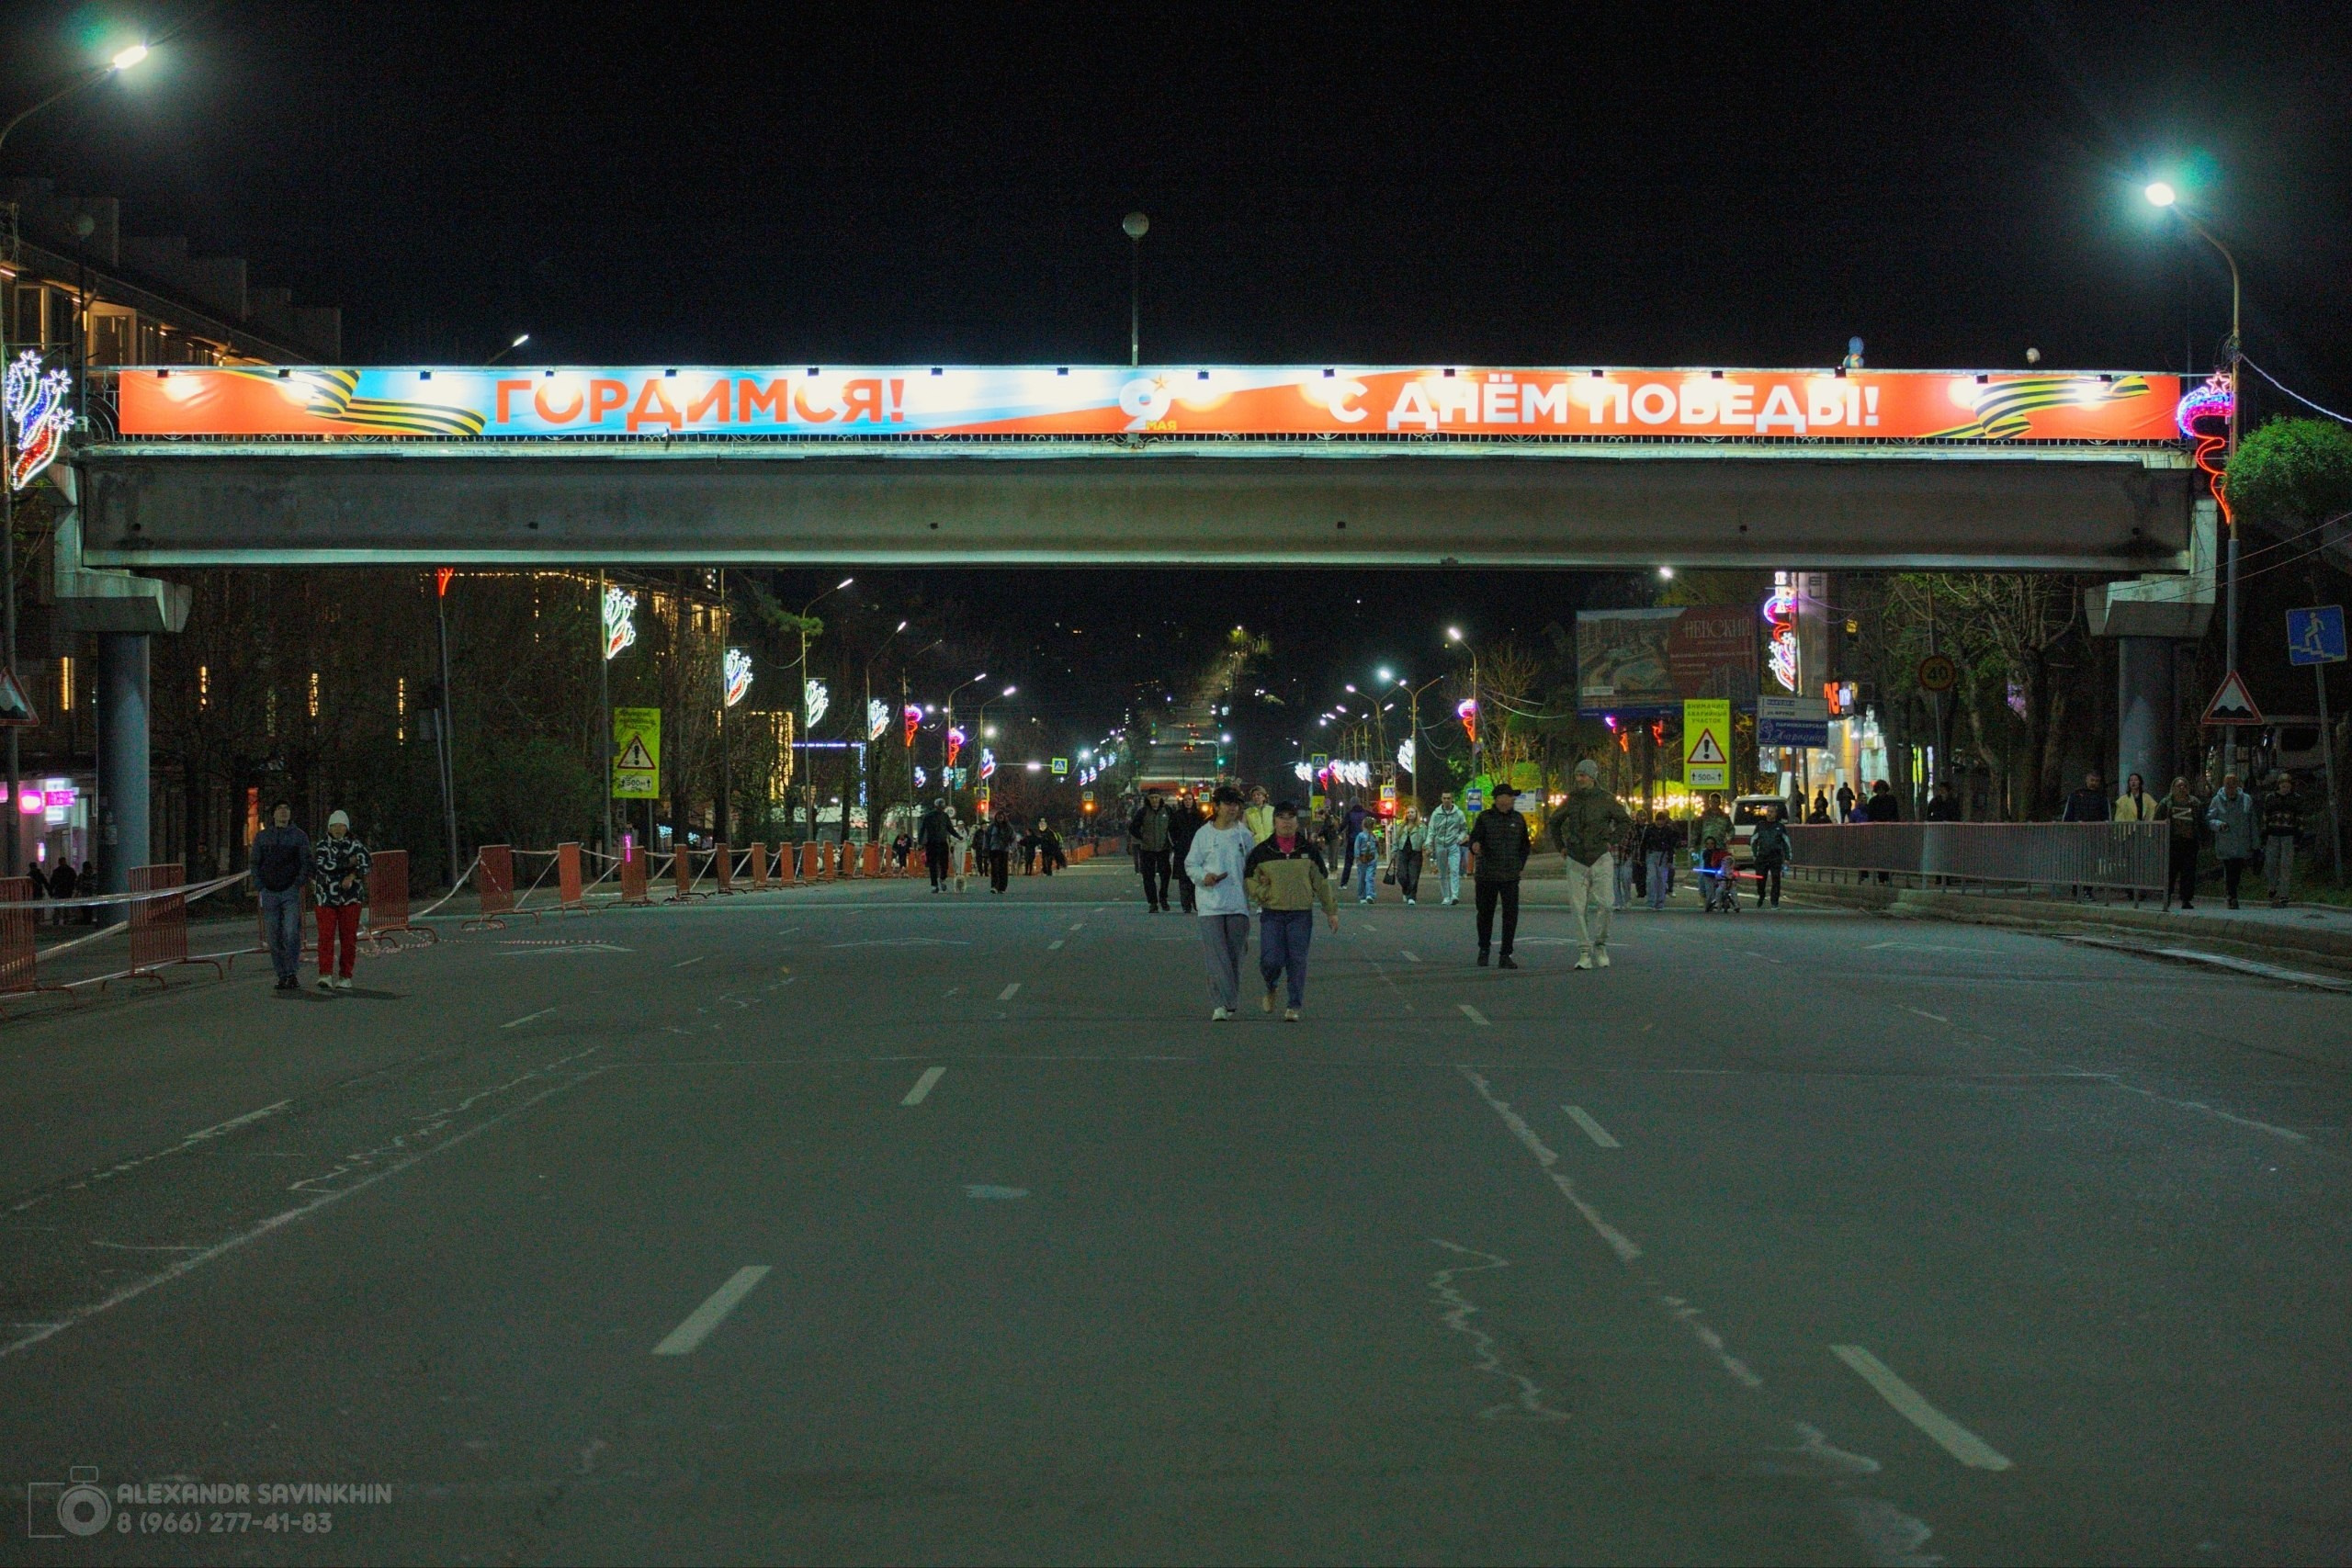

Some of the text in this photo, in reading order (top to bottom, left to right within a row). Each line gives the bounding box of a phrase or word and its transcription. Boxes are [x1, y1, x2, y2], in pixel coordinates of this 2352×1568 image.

[495, 378, 905, 432] ГОРДИМСЯ!
[1119, 378, 1171, 431] 9
[1386, 373, 1567, 431] ДНЁМ
[1589, 383, 1880, 434] ПОБЕДЫ!
[1146, 420, 1177, 431] МАЯ
[1682, 617, 1751, 638] НЕВСКИЙ
[1927, 666, 1949, 681] 40
